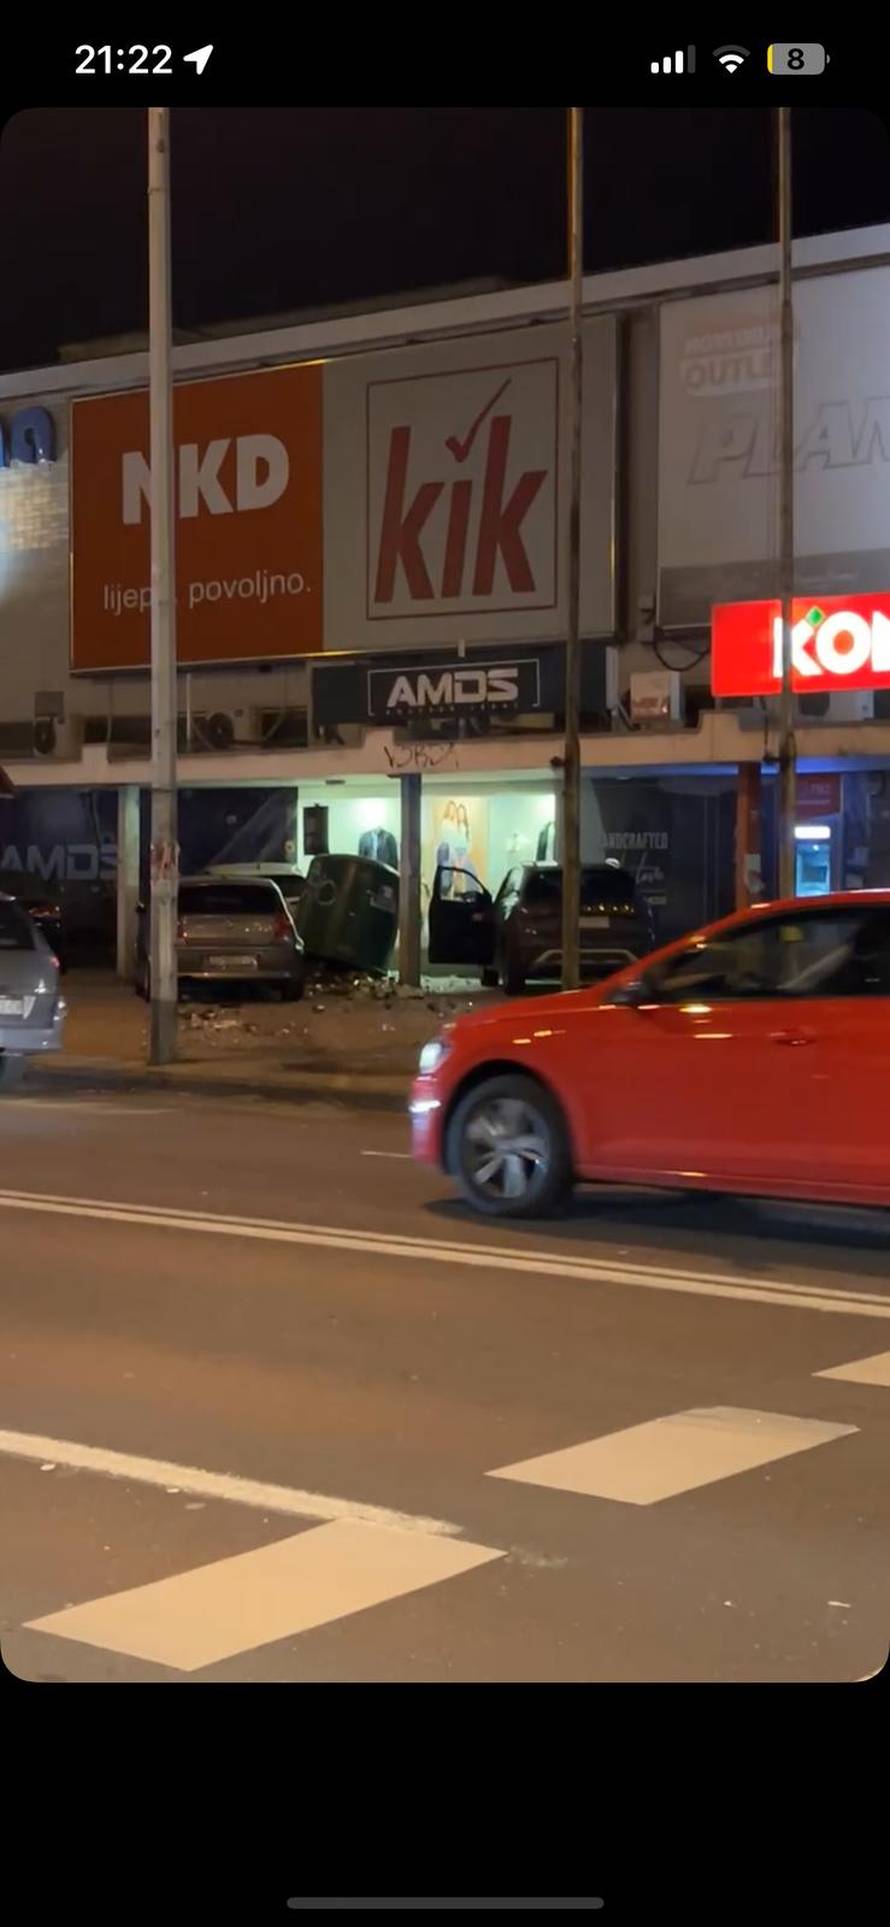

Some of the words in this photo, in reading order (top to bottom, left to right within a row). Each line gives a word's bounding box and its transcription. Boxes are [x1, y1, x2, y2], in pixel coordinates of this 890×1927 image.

[103, 583, 155, 616] lijep
[189, 569, 312, 610] povoljno.
[387, 668, 518, 708] AMDS
